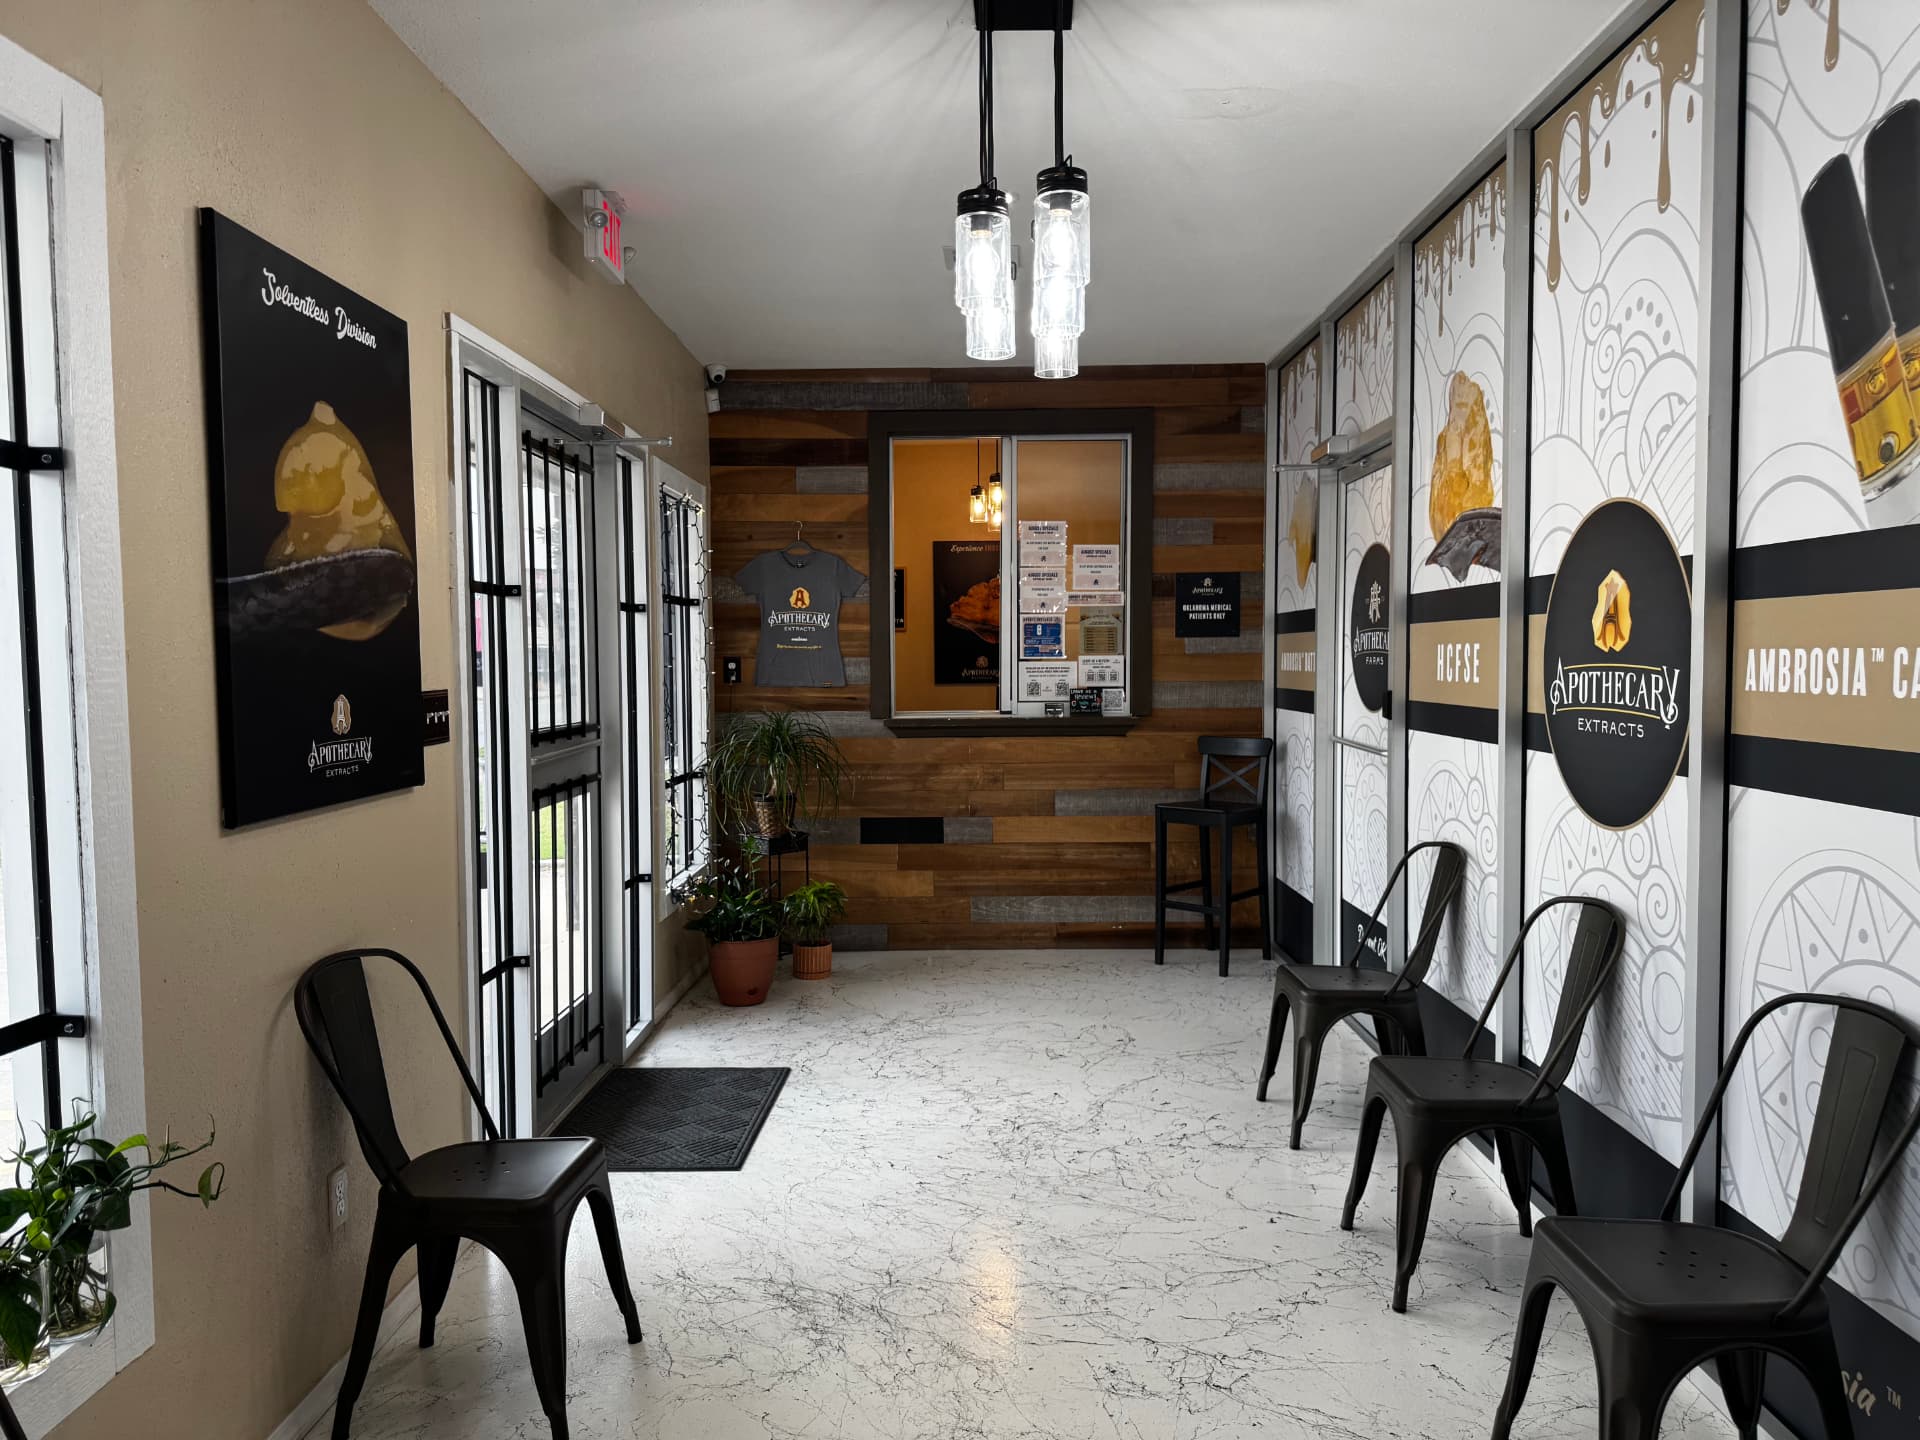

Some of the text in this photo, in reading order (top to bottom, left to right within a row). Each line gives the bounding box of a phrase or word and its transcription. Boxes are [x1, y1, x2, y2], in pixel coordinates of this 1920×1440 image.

[262, 267, 377, 349] Solventless Division
[1182, 604, 1232, 612] OKLAHOMA MEDICAL
[1189, 612, 1226, 620] PATIENTS ONLY
[768, 610, 831, 629] APOTHECARY
[1436, 643, 1480, 684] HCFSE
[1550, 656, 1680, 730] APOTHECARY
[1577, 717, 1645, 738] EXTRACTS
[308, 736, 373, 773] APOTHECARY
[325, 764, 360, 778] EXTRACTS
